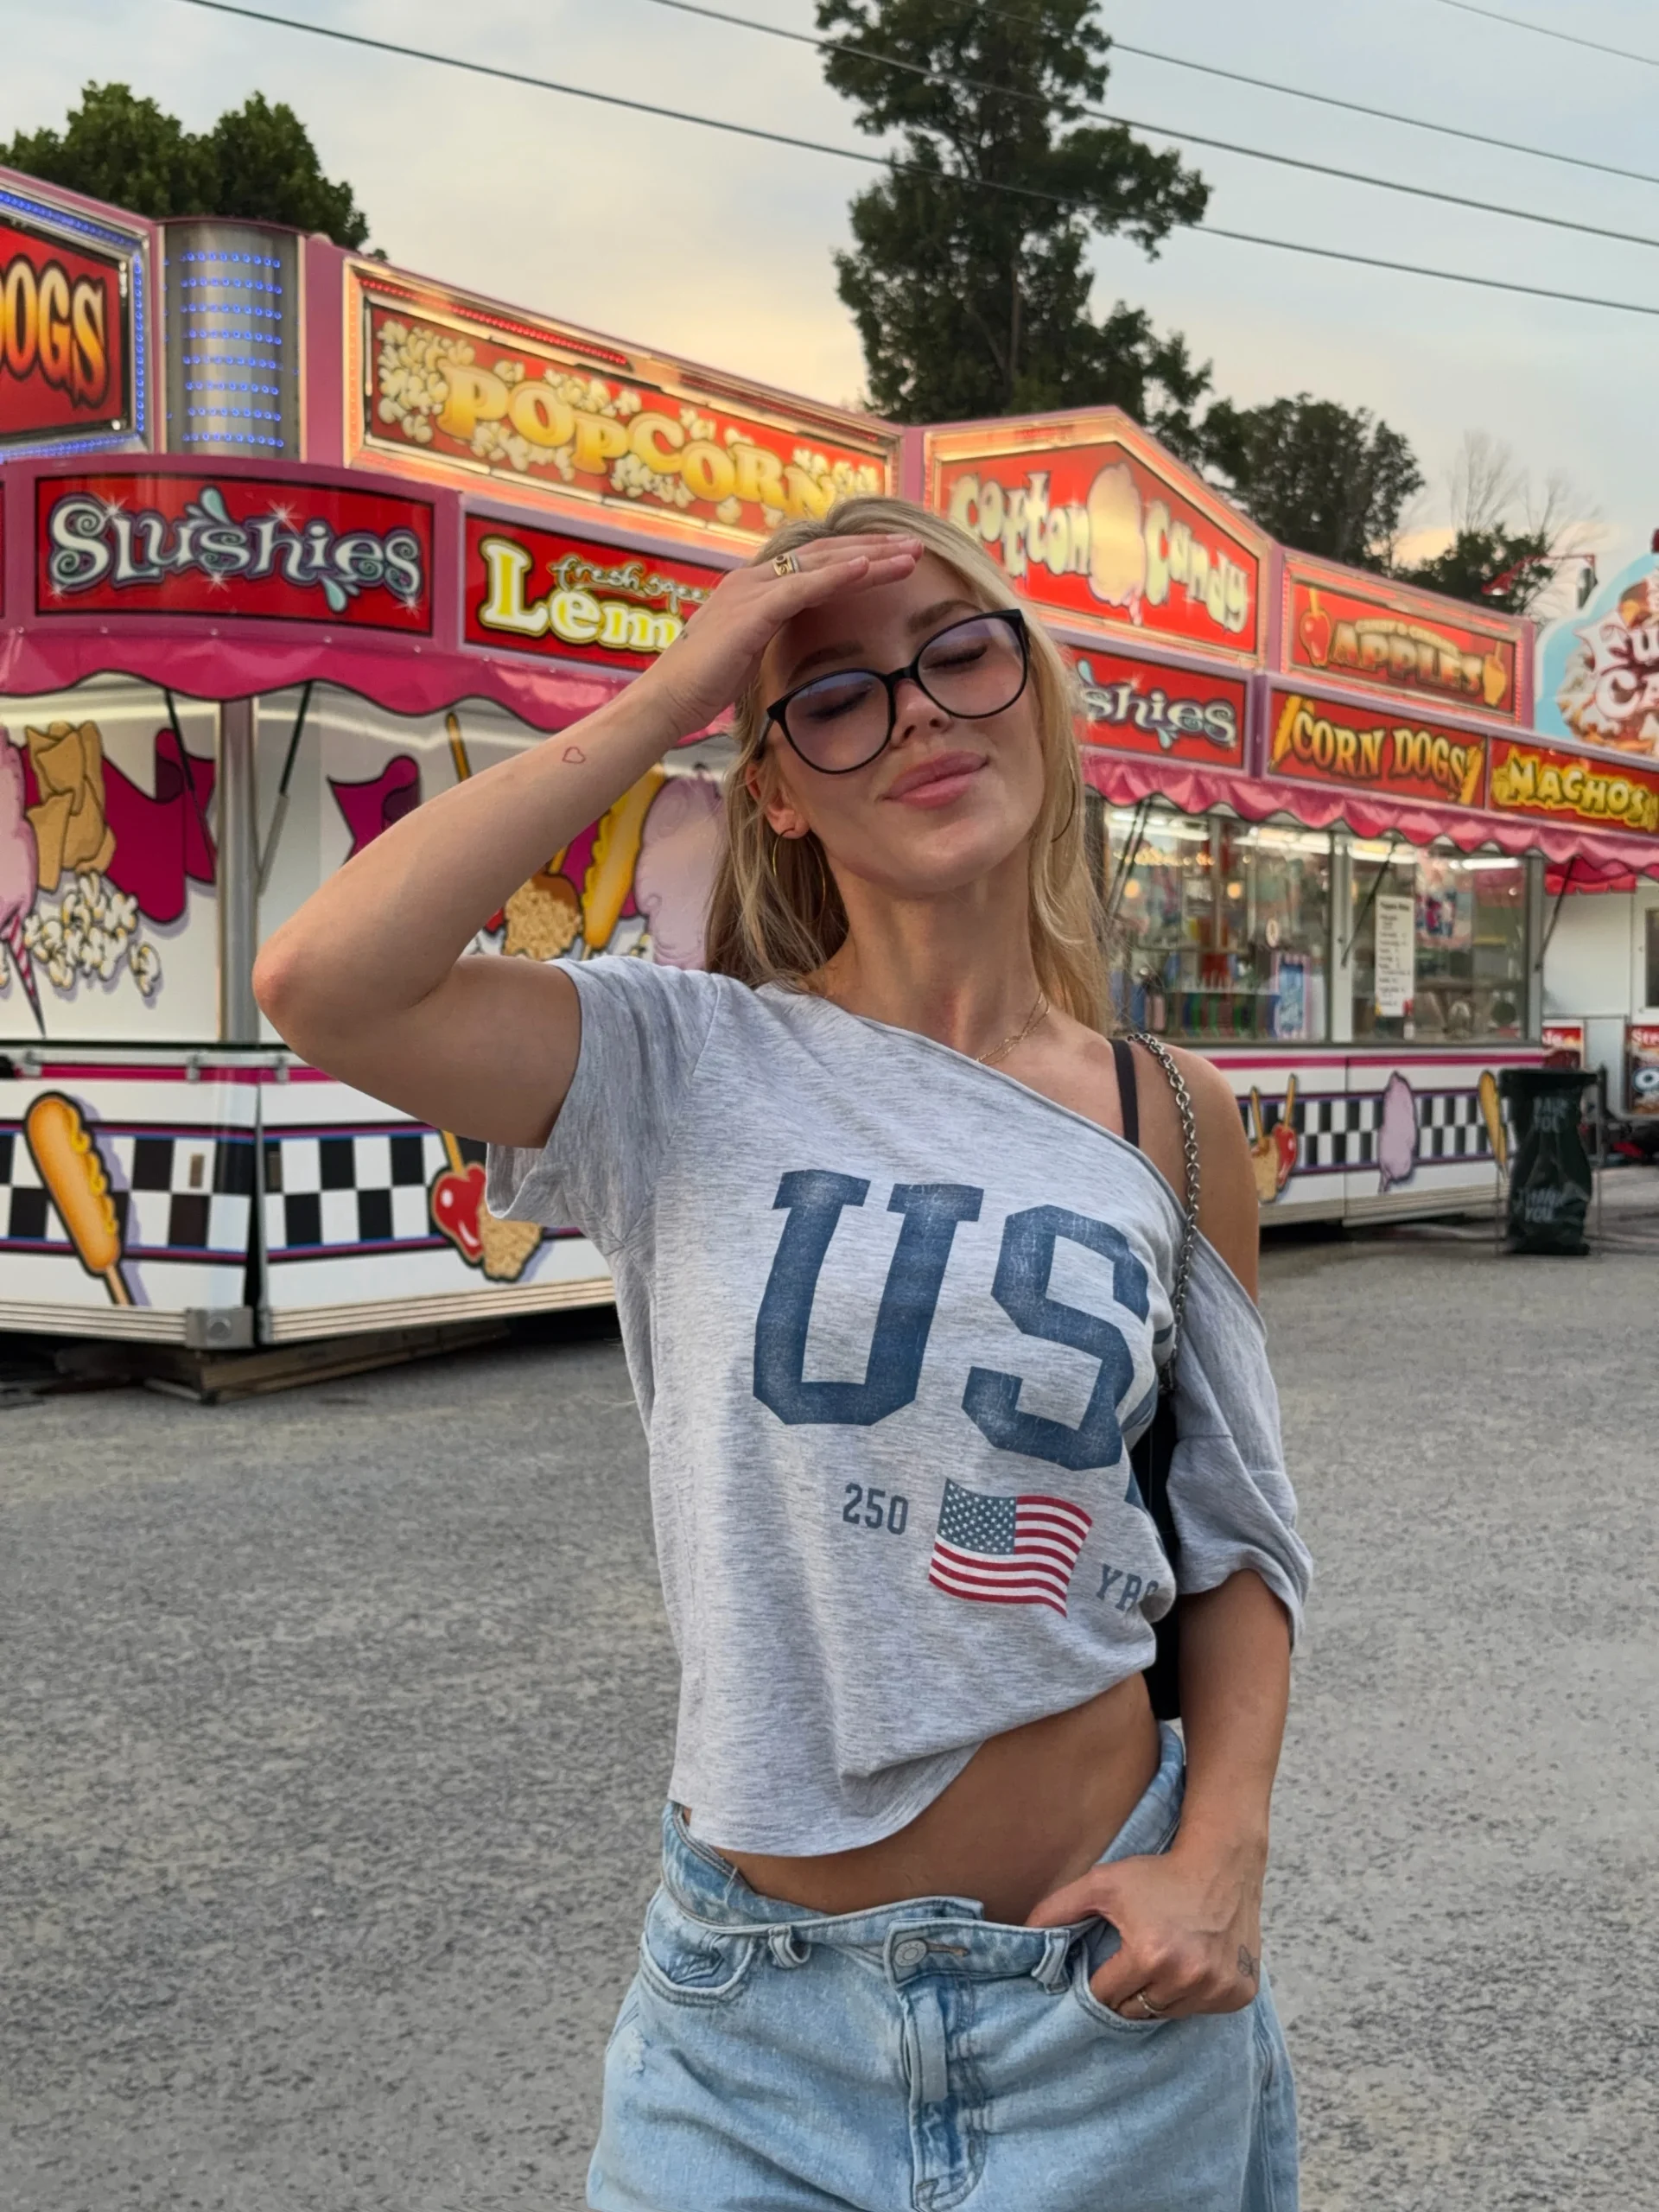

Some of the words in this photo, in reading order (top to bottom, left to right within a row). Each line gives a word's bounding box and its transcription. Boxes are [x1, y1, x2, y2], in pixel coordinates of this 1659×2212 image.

[0, 256, 105, 399] OGS
[437, 356, 836, 521] POPCORN
[50, 493, 423, 598] Slushies
[550, 553, 645, 594] fresh
[950, 469, 1092, 577] Cotton
[1145, 498, 1249, 633] Candy
[1294, 710, 1385, 776] CORN
[1392, 728, 1466, 790] DOGS
[1508, 756, 1648, 823] NACHOS
[753, 1168, 1159, 1495] US
[842, 1482, 909, 1535] 250
